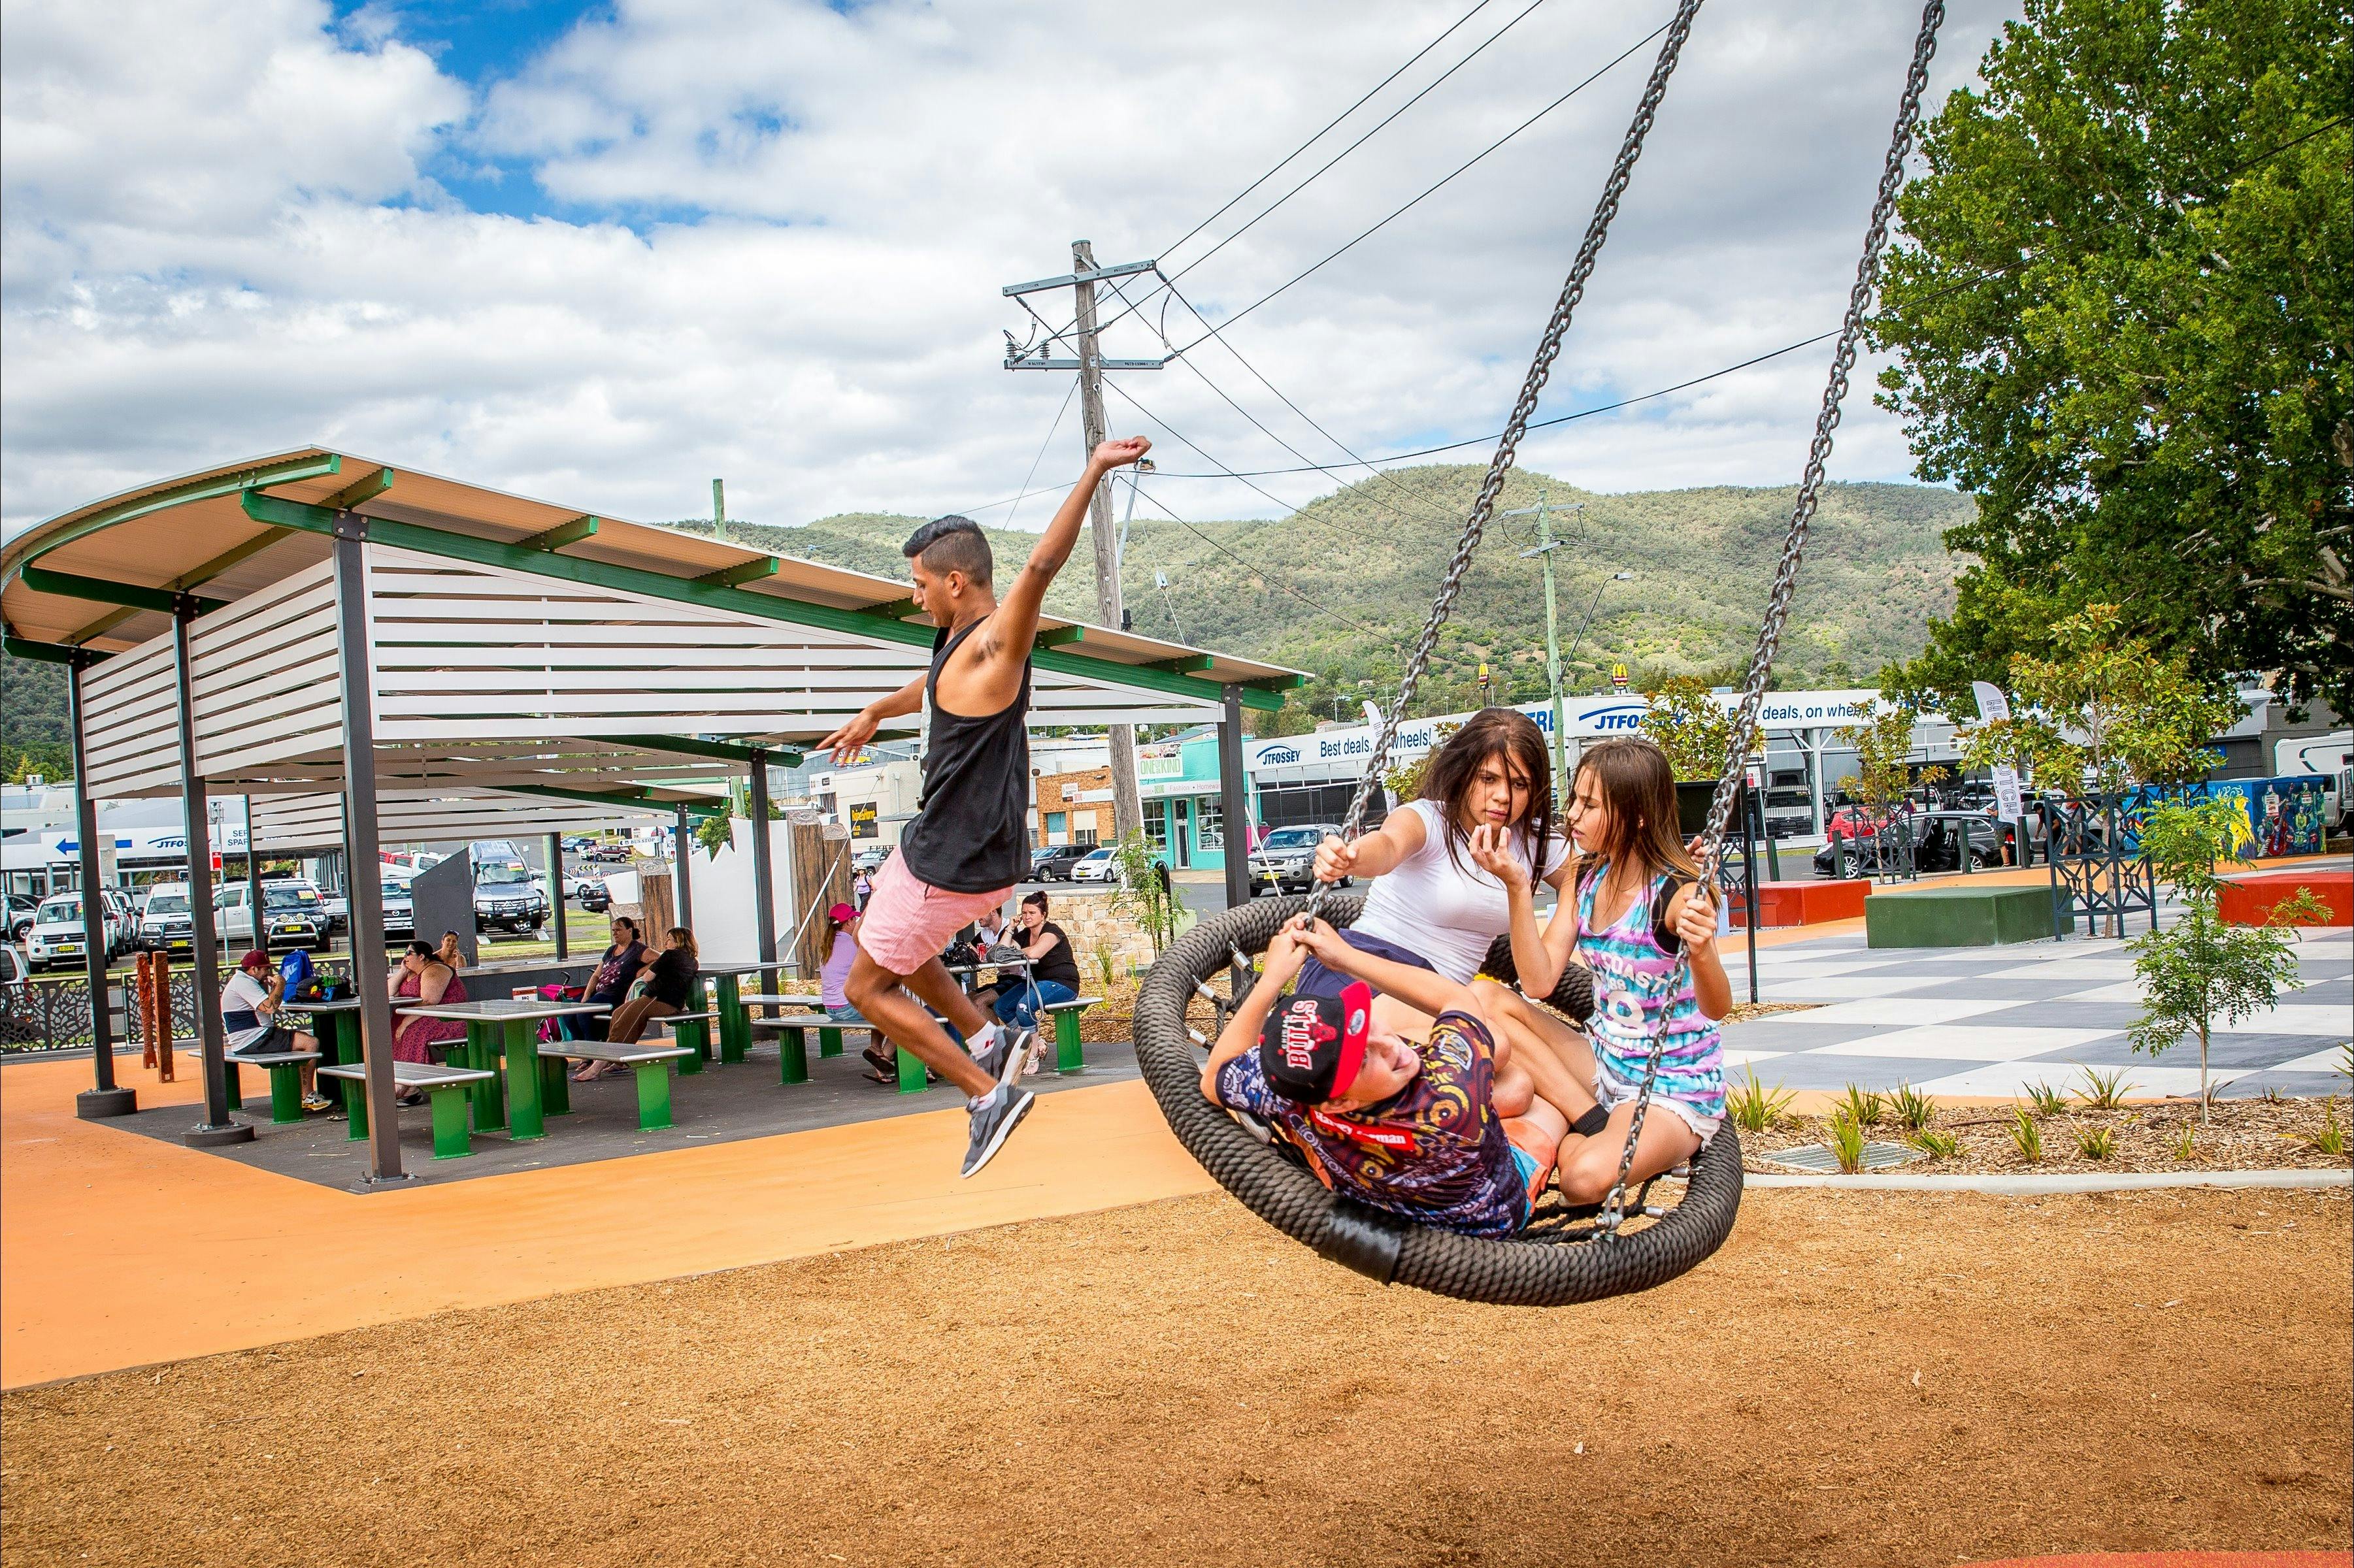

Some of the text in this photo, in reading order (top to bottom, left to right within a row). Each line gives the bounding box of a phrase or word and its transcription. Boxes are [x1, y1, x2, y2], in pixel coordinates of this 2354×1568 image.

[1763, 706, 1802, 721] deals,
[1805, 707, 1823, 719] on
[1321, 741, 1341, 758] Best
[1344, 736, 1372, 755] deals,
[1391, 727, 1431, 750] wheels!
[1140, 760, 1155, 775] ONE
[1161, 759, 1180, 774] KIND
[1262, 750, 1301, 766] JTFOSSEY
[1600, 951, 1668, 993] COAST
[1286, 1000, 1319, 1070] BULLS
